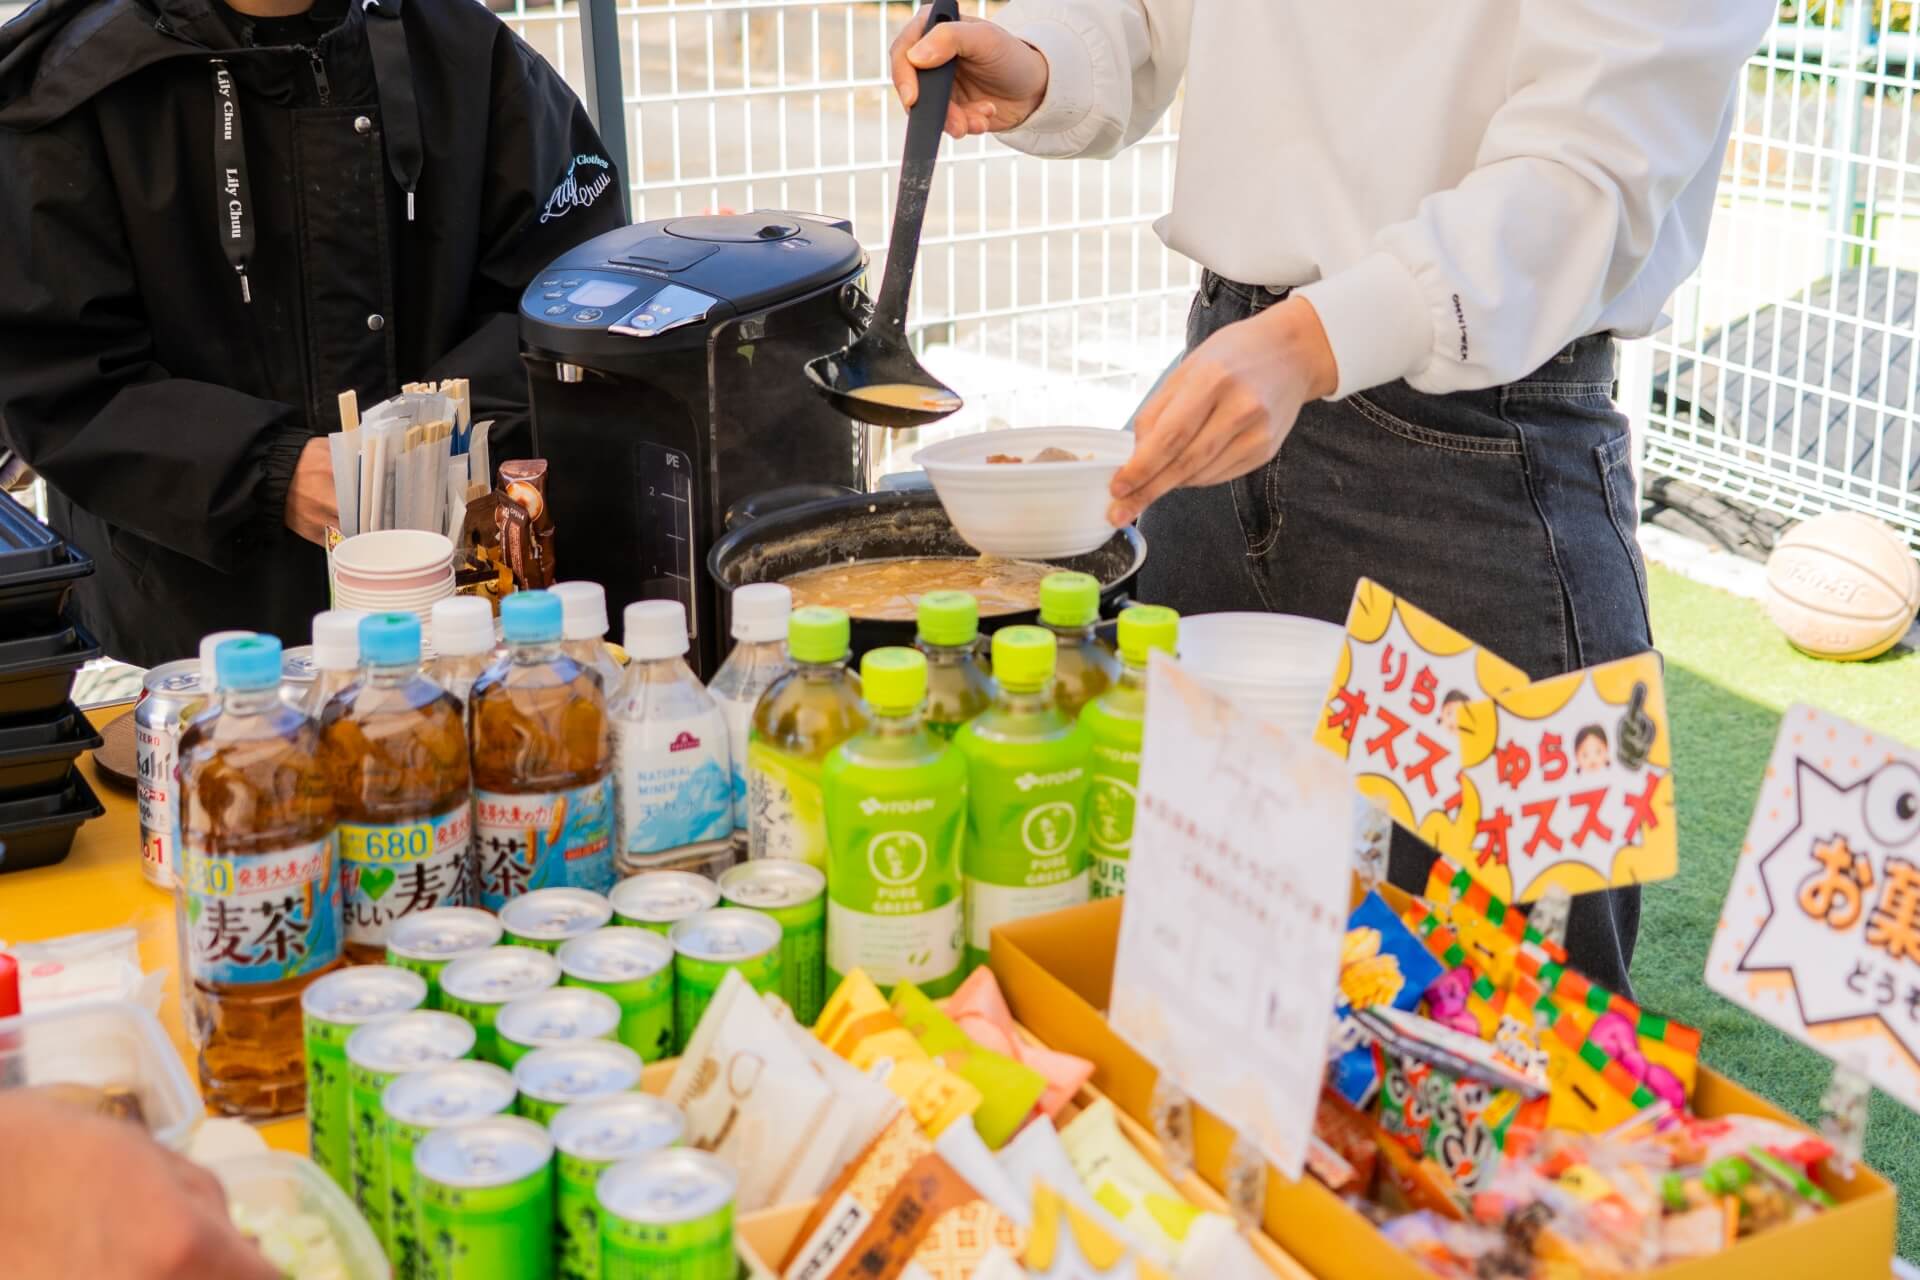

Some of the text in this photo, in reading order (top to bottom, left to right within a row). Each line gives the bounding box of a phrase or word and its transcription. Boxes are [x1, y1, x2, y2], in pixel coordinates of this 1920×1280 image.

[217, 70, 234, 140] Lily Chuu
[576, 154, 609, 169] Clothes
[225, 168, 243, 238] Lily Chuu
[1380, 643, 1439, 715] りら
[1494, 731, 1569, 790] ゆら
[366, 829, 428, 859] 680
[1475, 772, 1661, 869] オススメ
[475, 835, 531, 896] 茶
[203, 897, 309, 966] 麦茶
